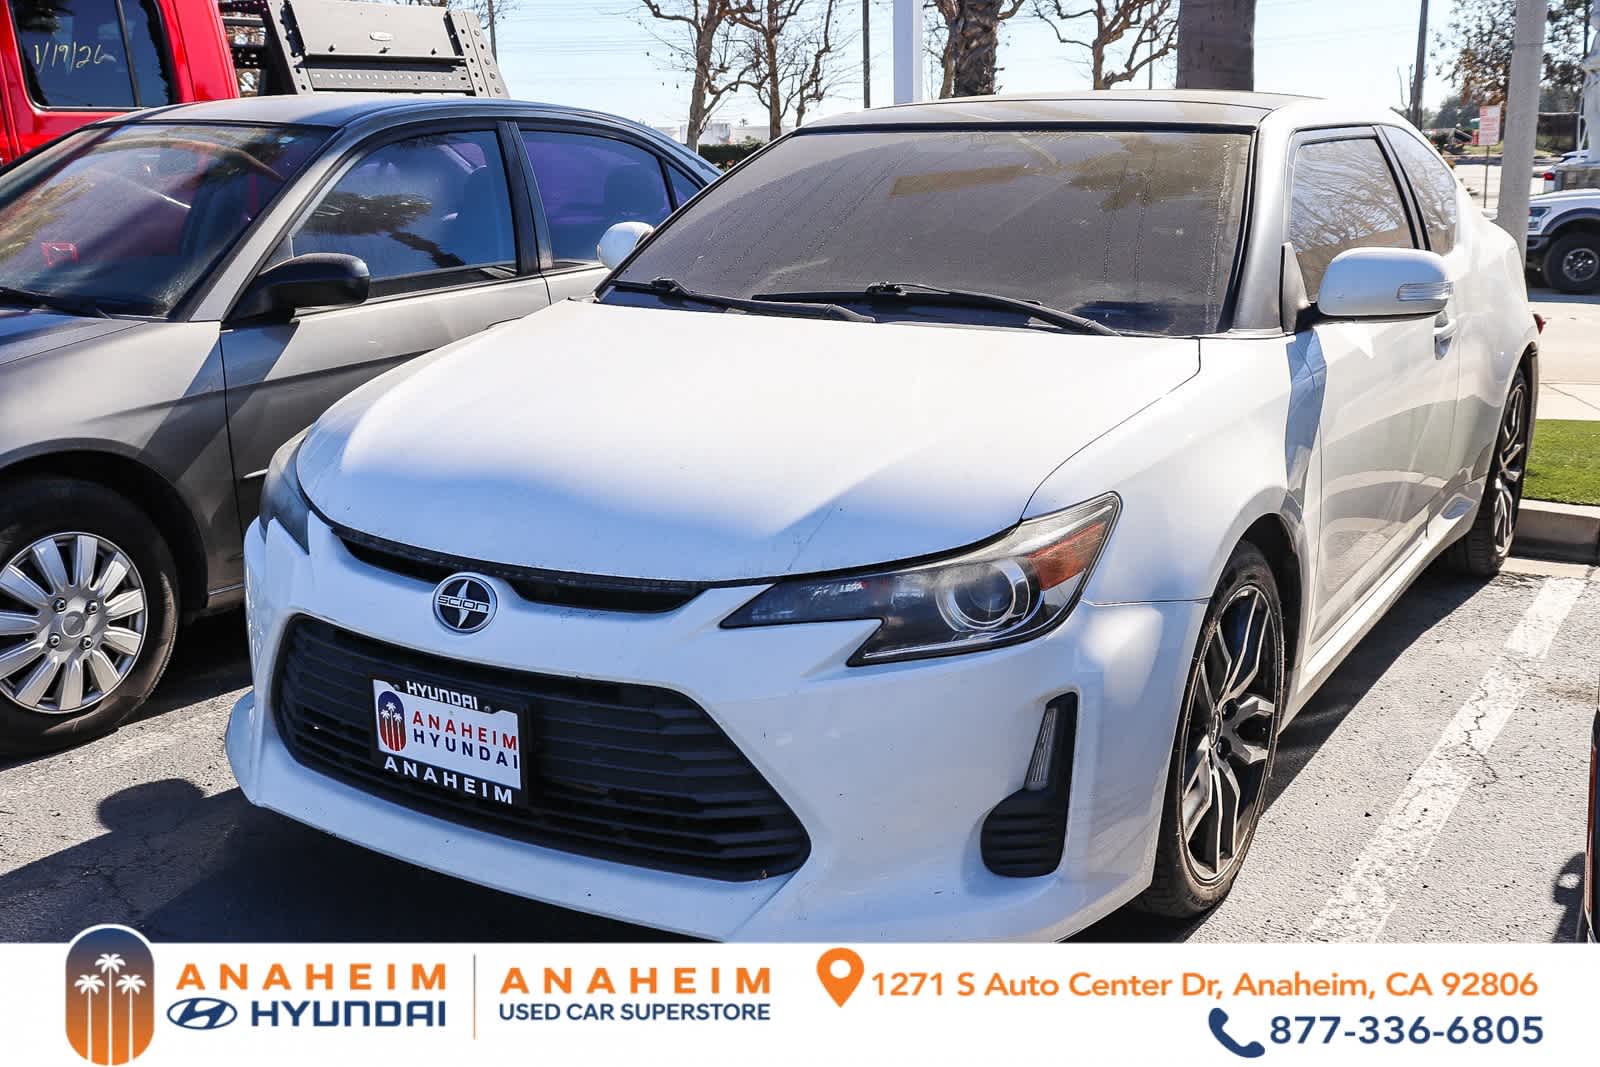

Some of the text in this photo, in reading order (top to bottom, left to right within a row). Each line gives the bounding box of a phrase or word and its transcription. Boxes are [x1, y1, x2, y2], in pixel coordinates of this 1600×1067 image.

[34, 41, 104, 73] 1/19/26
[406, 680, 478, 710] HYUNDAI
[412, 711, 517, 750] ANAHEIM
[413, 728, 518, 769] HYUNDAI
[384, 756, 513, 805] ANAHEIM
